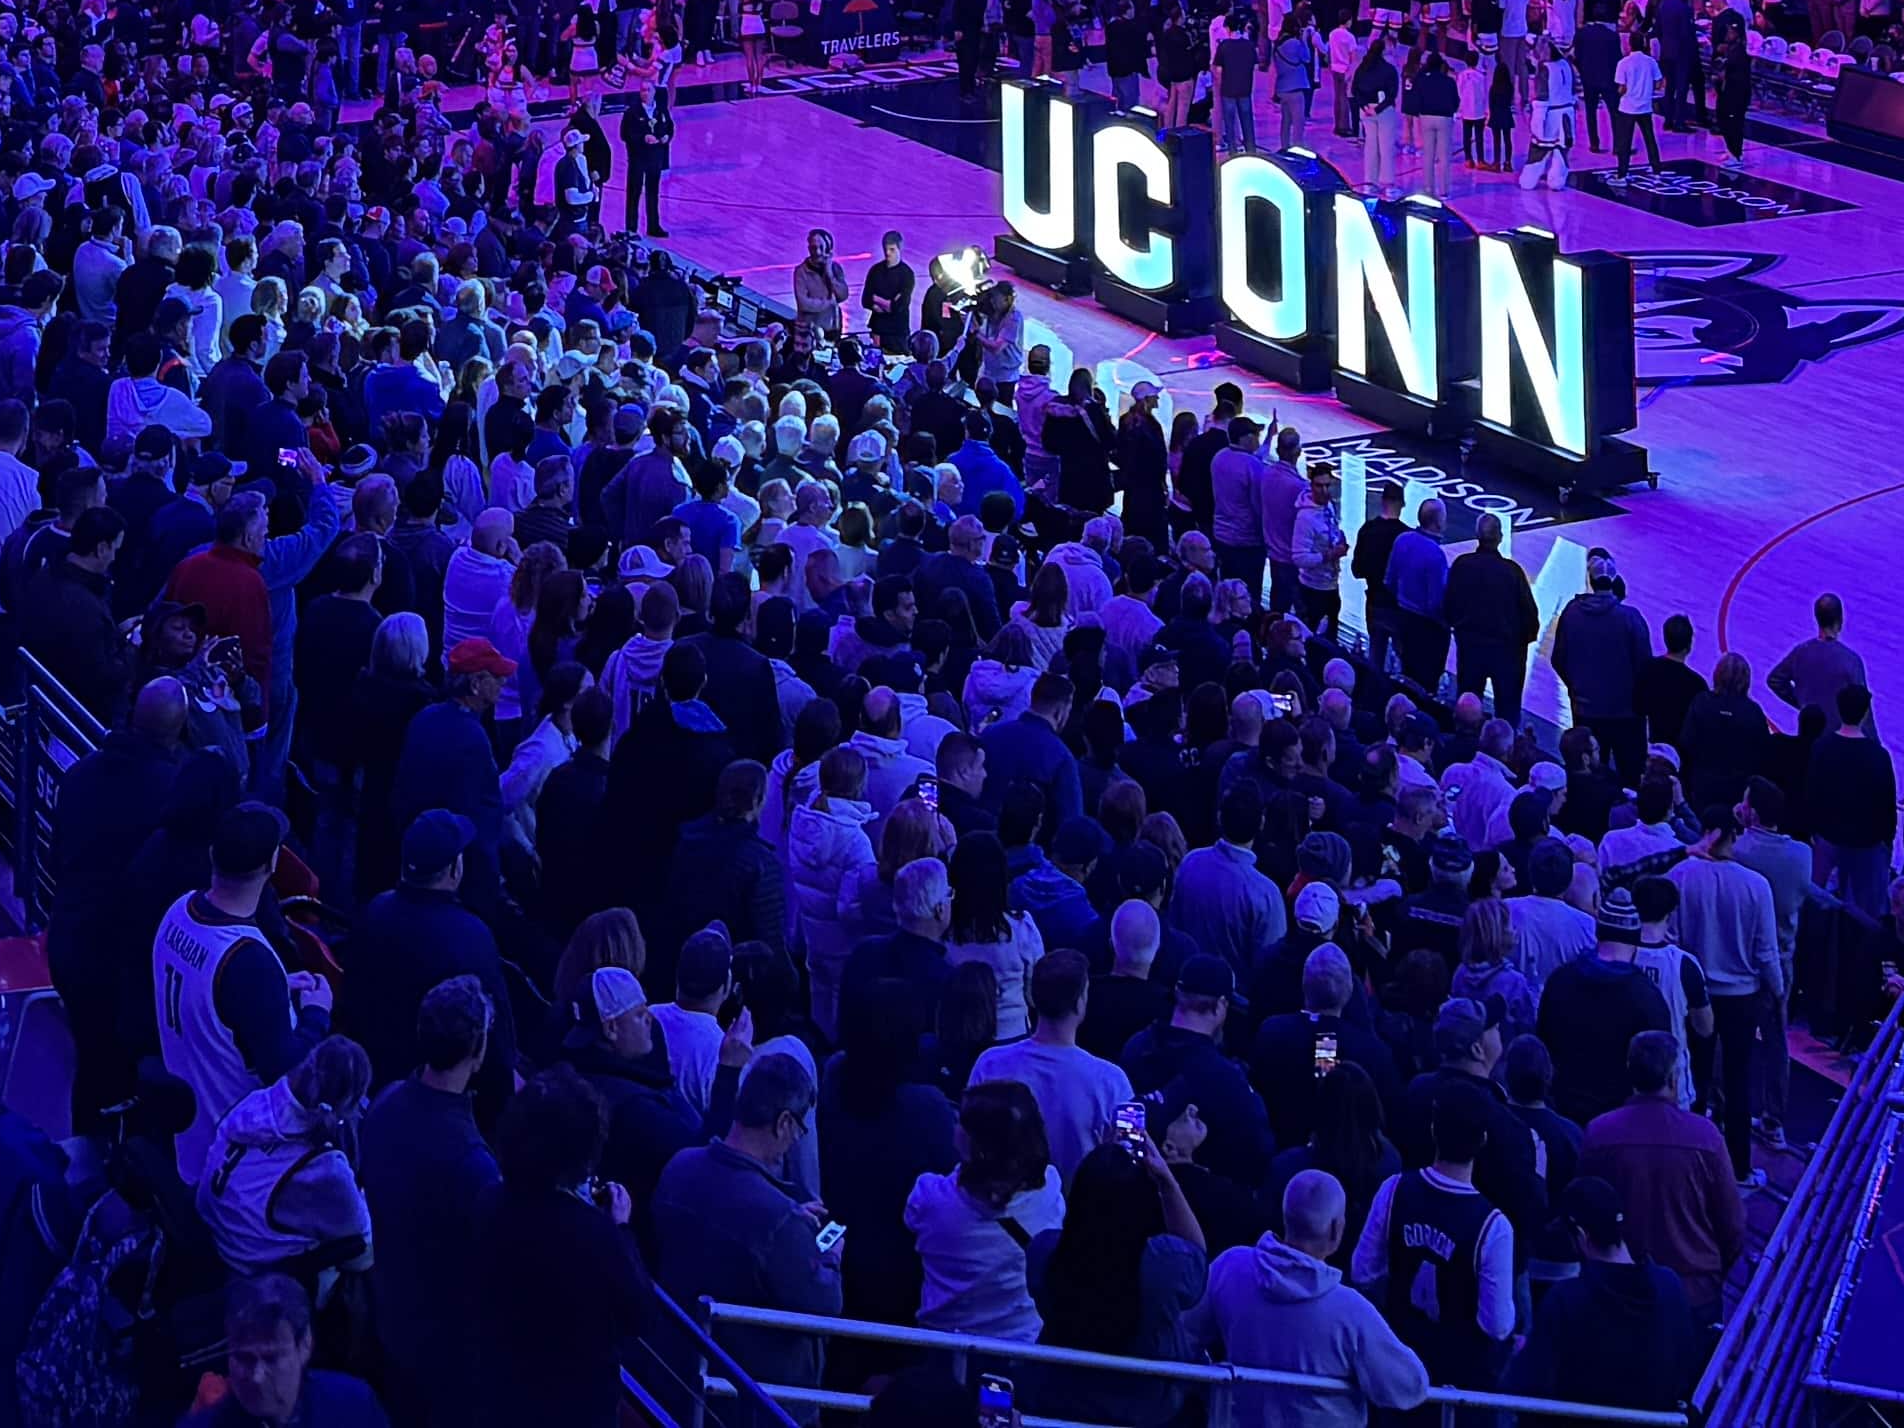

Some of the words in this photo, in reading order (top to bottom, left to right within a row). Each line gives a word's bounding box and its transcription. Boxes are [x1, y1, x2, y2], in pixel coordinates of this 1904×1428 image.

[821, 32, 900, 55] TRAVELERS
[1000, 76, 1590, 458] UCONN
[1330, 438, 1554, 528] MADISON
